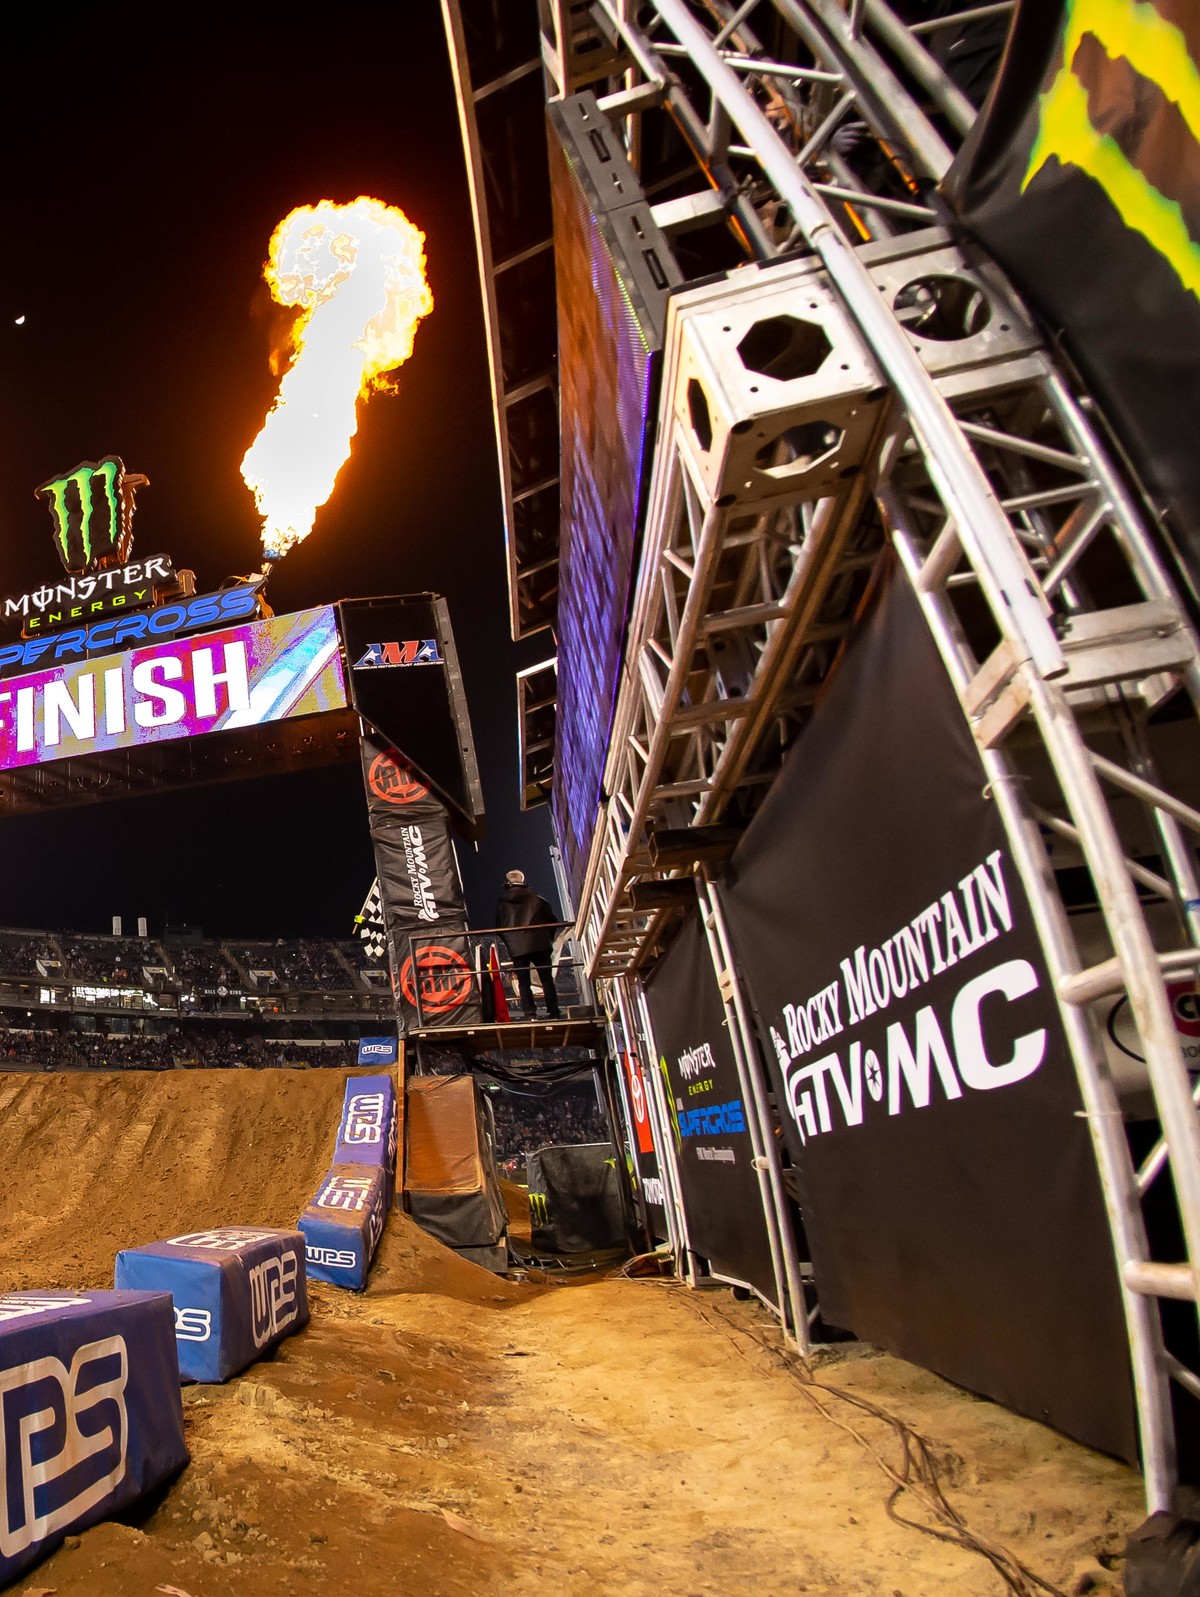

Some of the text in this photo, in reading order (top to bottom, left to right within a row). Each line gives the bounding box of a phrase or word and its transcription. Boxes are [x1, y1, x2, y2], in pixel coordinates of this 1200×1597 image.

[4, 557, 170, 618] MONSTER
[29, 589, 147, 628] ENERGY
[352, 639, 444, 667] AMA
[400, 827, 424, 908] ROCKY MOUNTAIN
[782, 849, 1013, 1059] ROCKY MOUNTAIN
[361, 1045, 393, 1055] WPS
[678, 1042, 716, 1080] MONSTER
[688, 1079, 714, 1096] ENERGY
[305, 1245, 356, 1268] WPS
[249, 1250, 299, 1349] WPS
